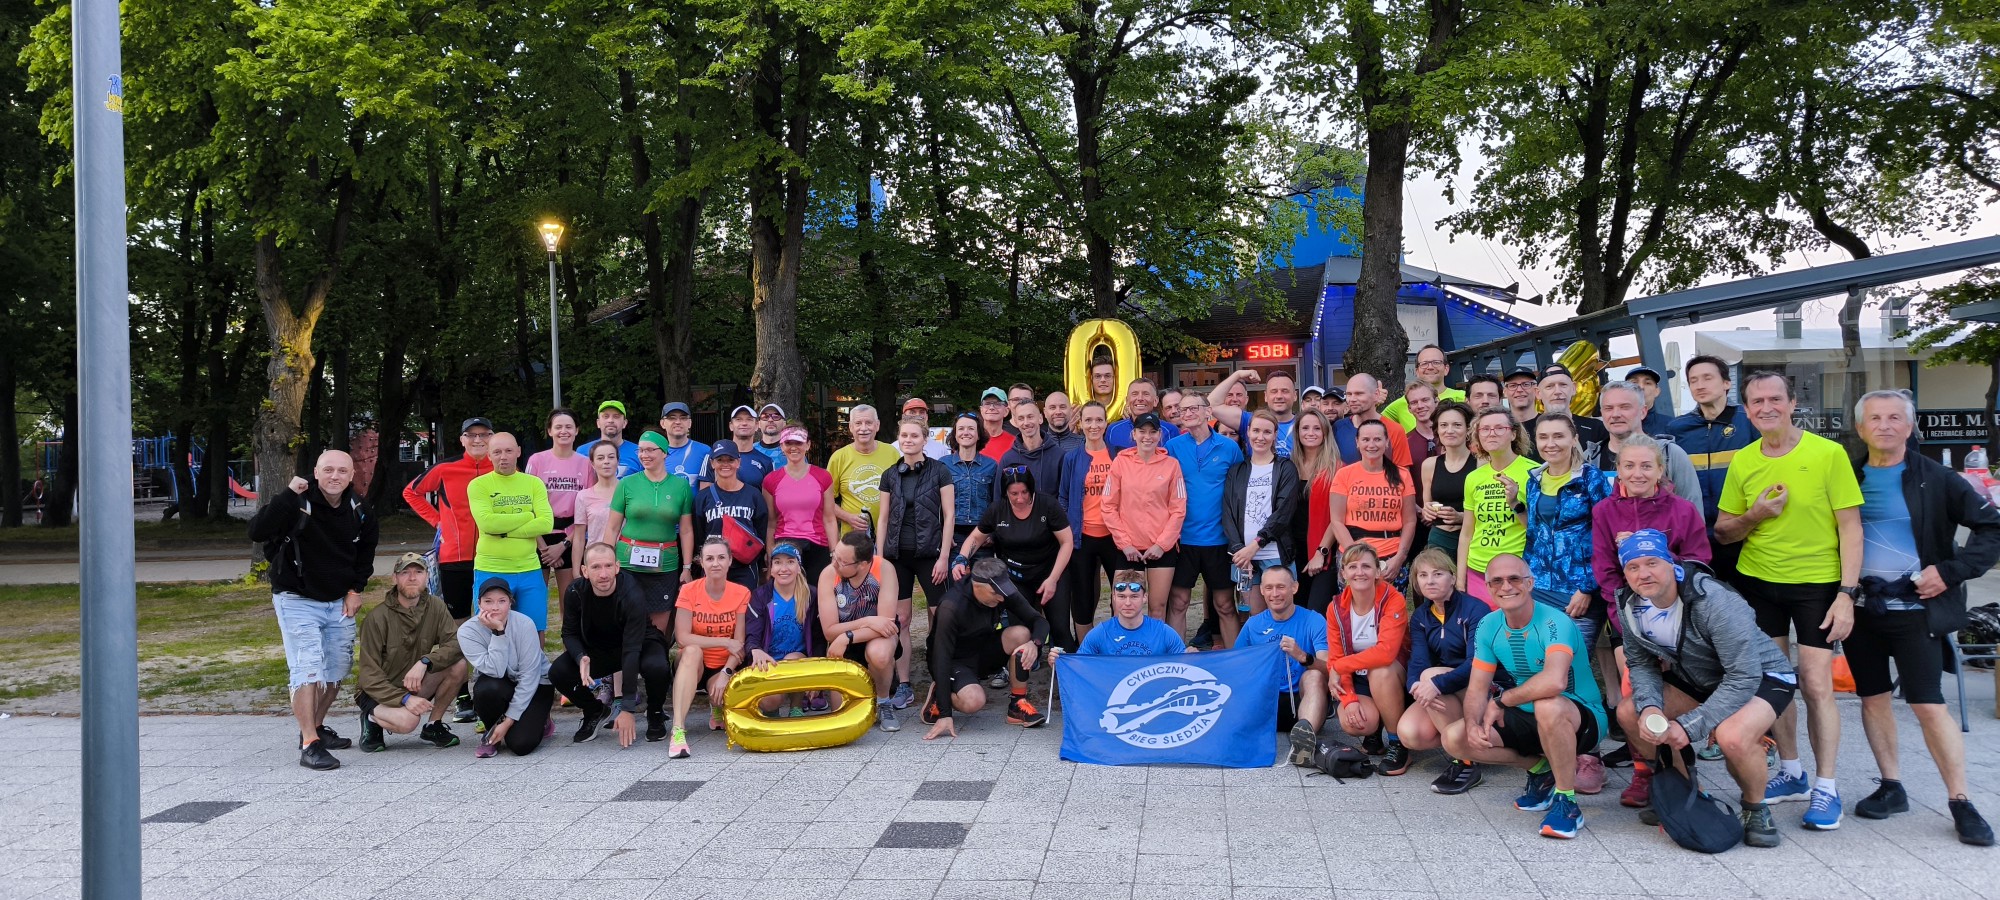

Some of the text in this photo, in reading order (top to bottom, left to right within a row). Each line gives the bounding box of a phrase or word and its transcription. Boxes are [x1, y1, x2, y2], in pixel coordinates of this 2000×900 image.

[1927, 414, 1961, 427] DEL
[1350, 485, 1401, 496] POMORZE
[1477, 513, 1515, 523] CALM
[1480, 537, 1500, 547] ON
[640, 554, 657, 564] 113
[1126, 665, 1188, 687] CYKLICZNY
[1128, 717, 1211, 745] BIEG ŚLEDZIA
